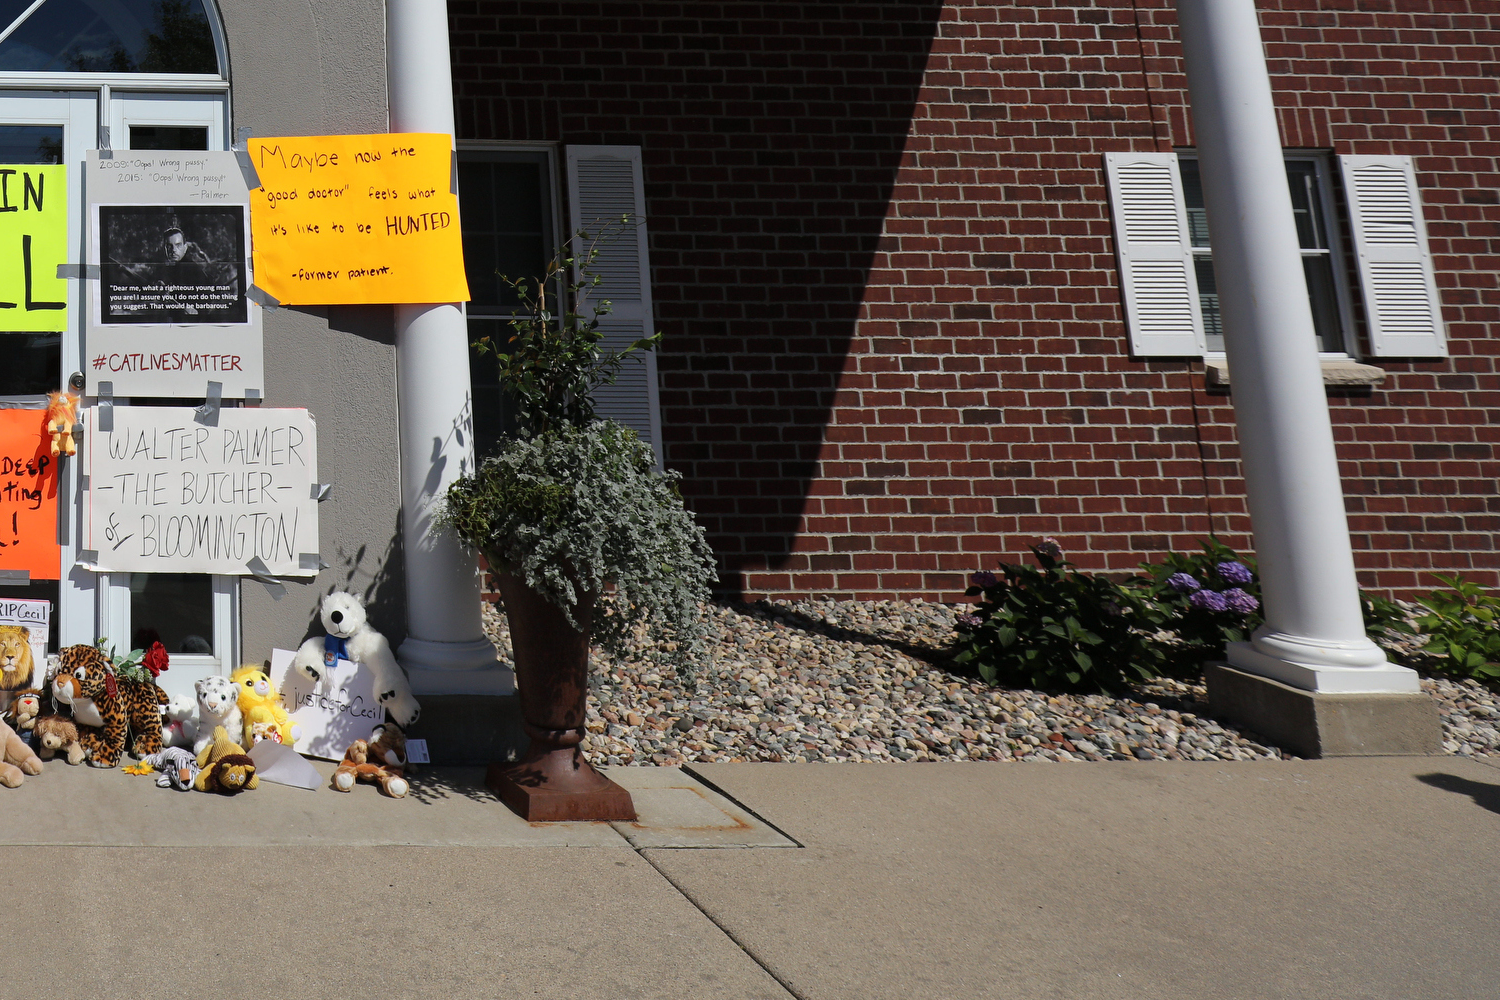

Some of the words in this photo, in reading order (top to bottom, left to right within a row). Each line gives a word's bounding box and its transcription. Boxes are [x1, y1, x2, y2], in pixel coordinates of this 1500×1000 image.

[160, 159, 180, 172] Wrong
[261, 145, 338, 173] Maybe
[354, 151, 382, 164] now
[391, 146, 416, 158] the
[118, 173, 143, 182] 2015:
[176, 174, 200, 186] Wrong
[308, 184, 349, 200] doctor"
[368, 186, 398, 200] feels
[408, 188, 436, 200] what
[297, 223, 320, 234] like
[332, 222, 344, 233] to
[356, 223, 372, 234] be
[386, 212, 450, 236] HUNTED
[348, 266, 394, 281] patient.
[92, 352, 243, 372] #CATLIVESMATTER
[109, 426, 210, 464] WALTER
[224, 426, 305, 466] PALMER
[1, 455, 50, 476] DEEP
[140, 507, 298, 562] BLOOMINGTON
[18, 604, 45, 620] Cecil
